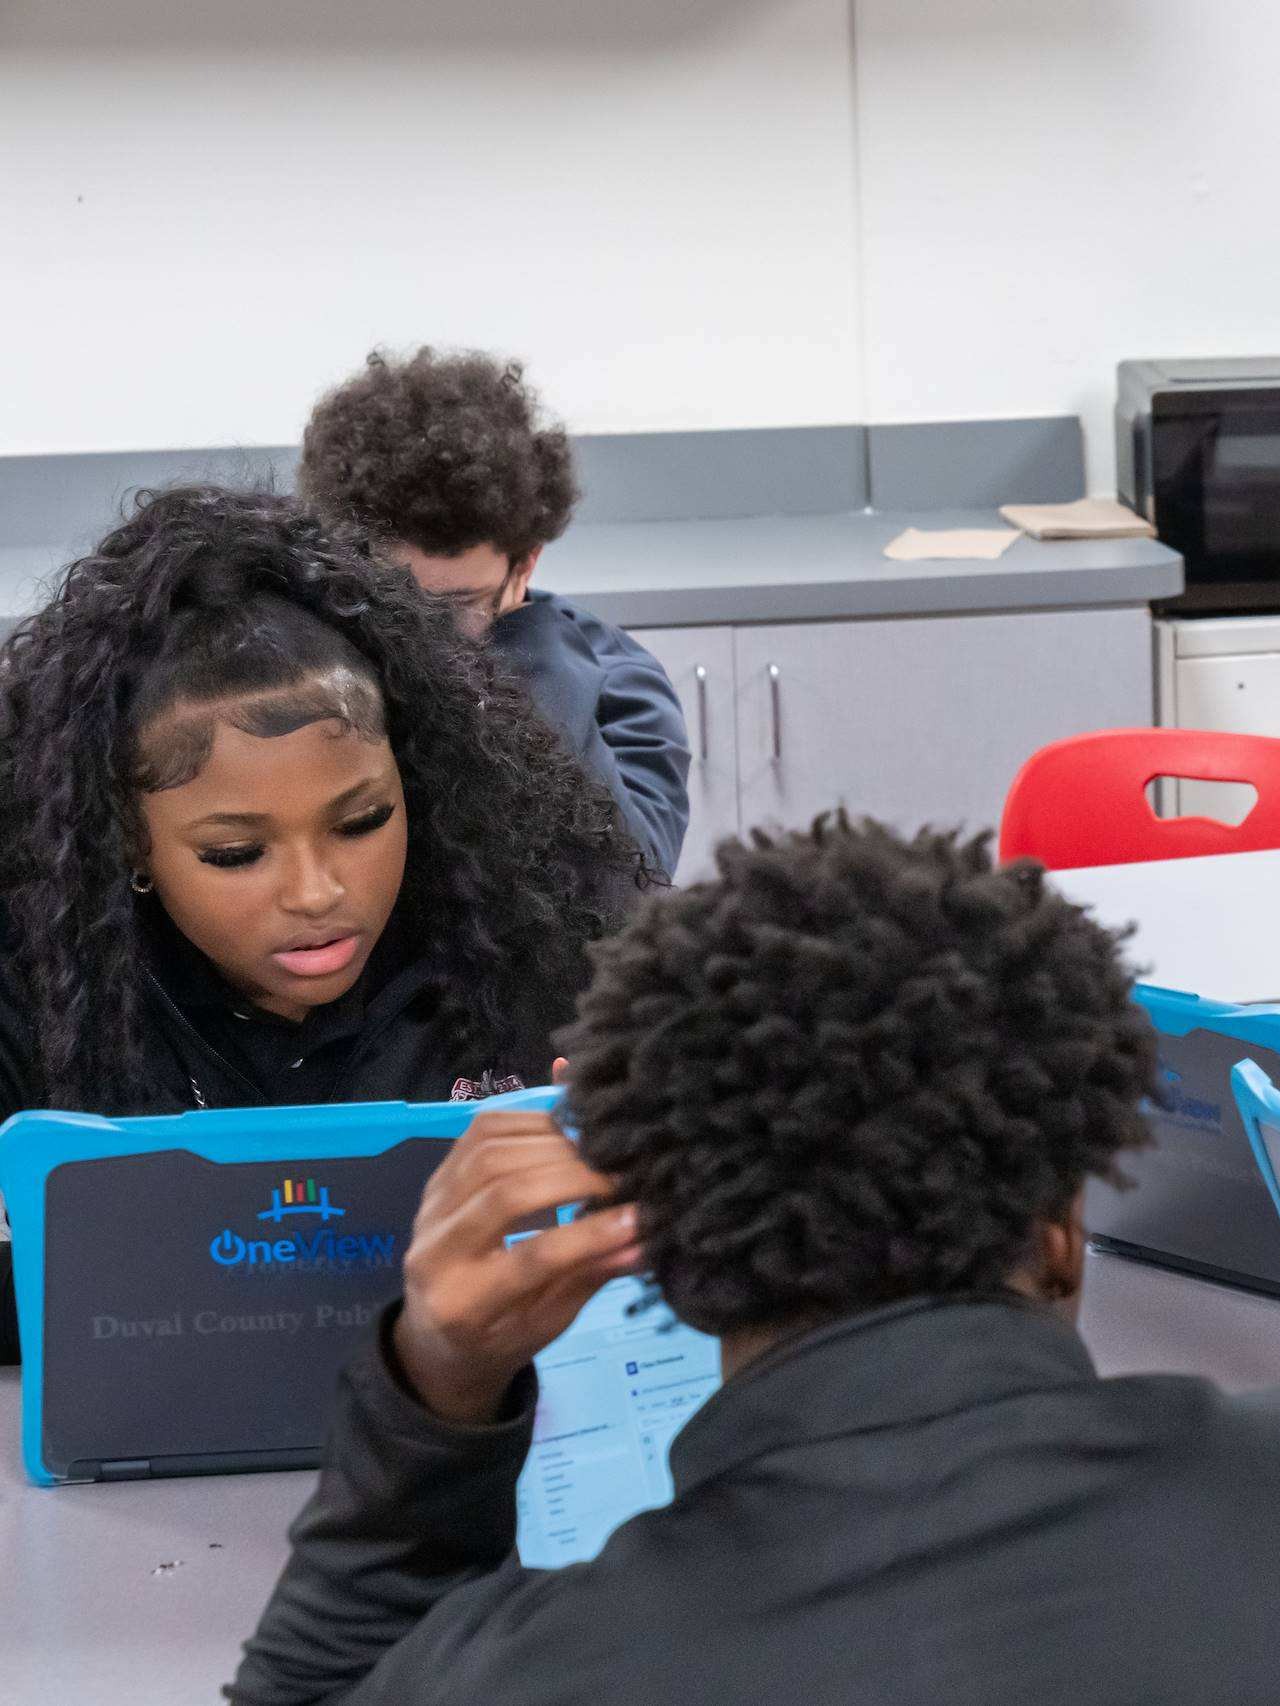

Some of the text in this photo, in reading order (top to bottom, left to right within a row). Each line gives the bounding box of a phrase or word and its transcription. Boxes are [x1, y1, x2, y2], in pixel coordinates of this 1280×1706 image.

[209, 1229, 395, 1265] OneView
[92, 1311, 182, 1339] Duval
[193, 1309, 304, 1334] County
